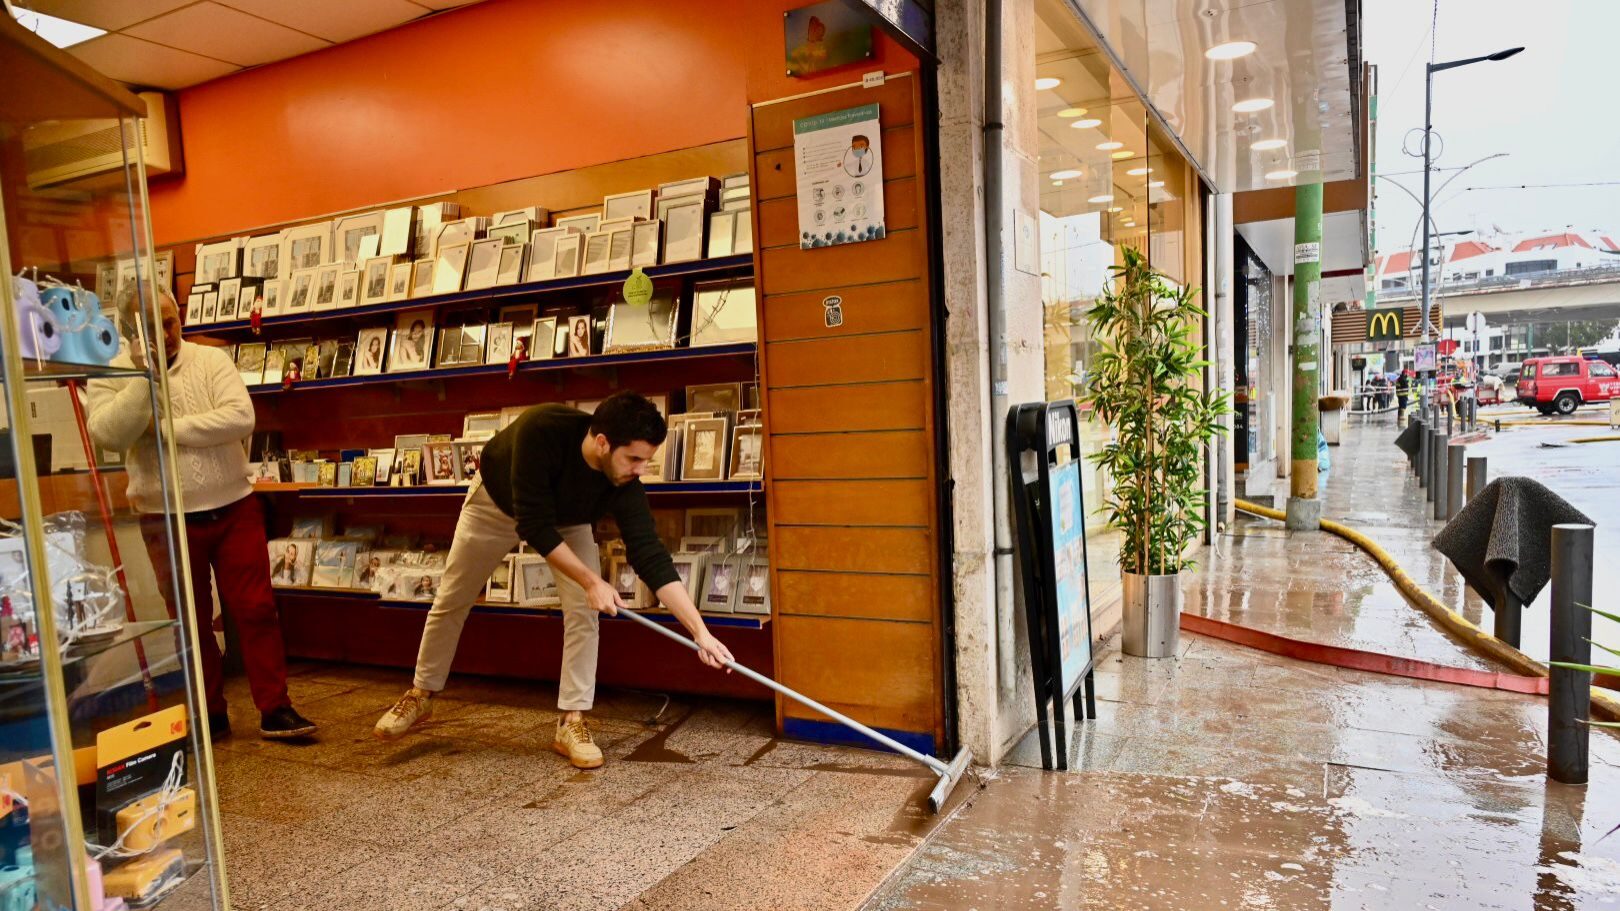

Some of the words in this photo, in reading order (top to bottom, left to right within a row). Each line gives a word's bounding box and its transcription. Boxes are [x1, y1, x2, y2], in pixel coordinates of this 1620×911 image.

[1370, 311, 1400, 338] M
[1048, 411, 1071, 446] Nikon
[137, 753, 156, 764] Camera
